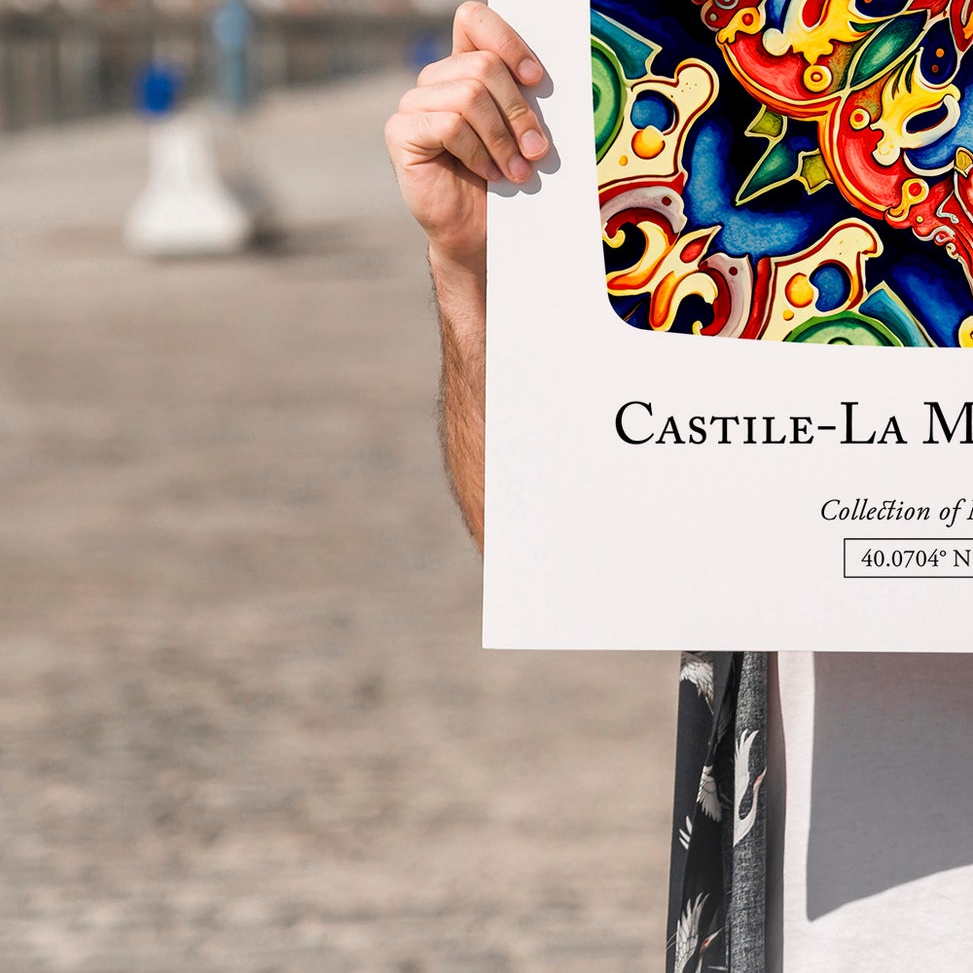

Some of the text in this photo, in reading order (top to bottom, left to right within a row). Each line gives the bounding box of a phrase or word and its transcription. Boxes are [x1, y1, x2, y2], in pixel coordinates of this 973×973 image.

[820, 498, 930, 521] Collection
[939, 498, 966, 528] of
[860, 548, 947, 568] 40.0704°
[953, 549, 972, 567] N
